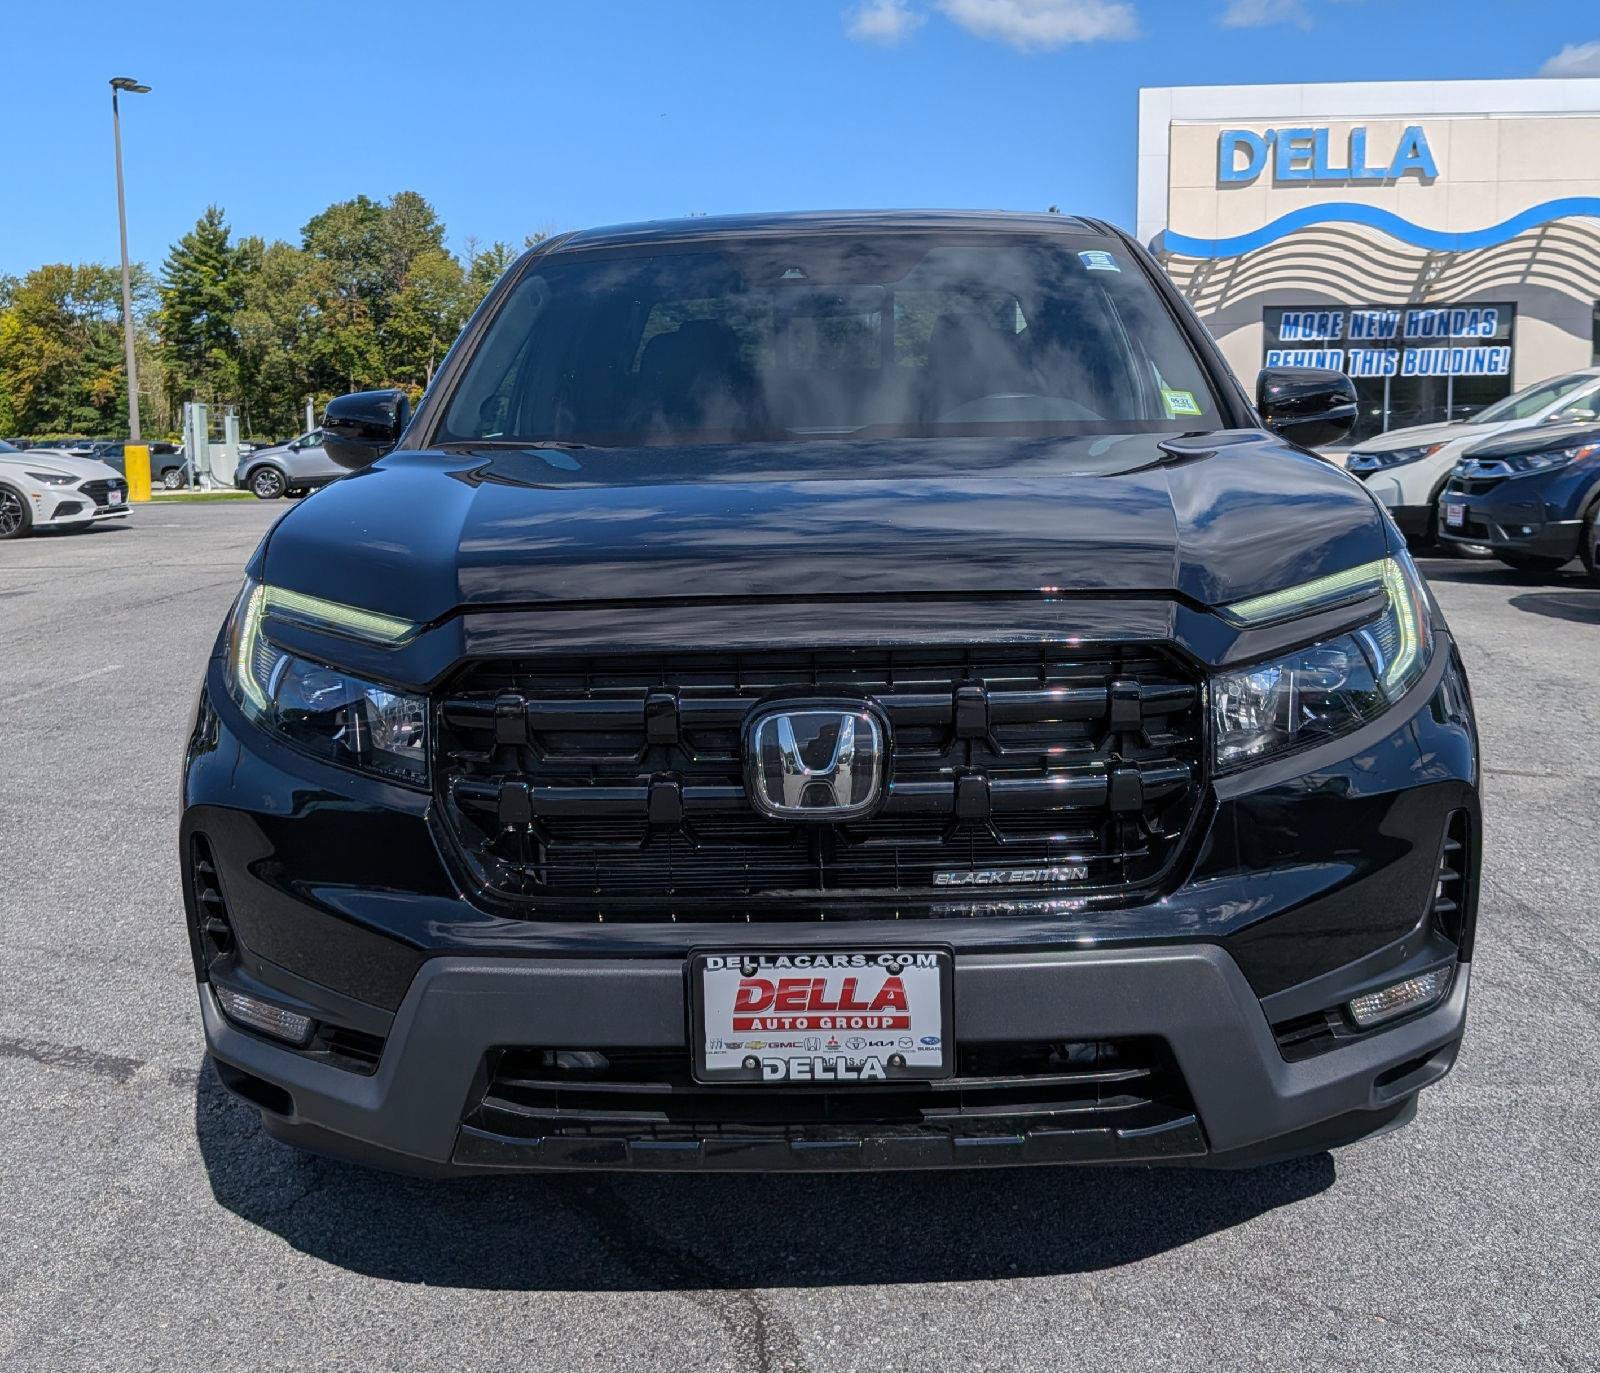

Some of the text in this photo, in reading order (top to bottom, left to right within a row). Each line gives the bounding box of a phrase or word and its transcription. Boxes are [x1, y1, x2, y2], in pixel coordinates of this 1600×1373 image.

[1217, 125, 1440, 185] D'ELLA
[1279, 308, 1498, 341] MORE NEW HONDAS
[1348, 348, 1399, 377] THIS
[1401, 346, 1511, 376] BUILDING!
[934, 867, 1087, 885] BLACK EDITION
[706, 953, 938, 971] DELLACARS.COM
[733, 976, 909, 1014] DELLA
[751, 1016, 895, 1030] AUTO GROUP
[768, 1041, 803, 1050] GMC
[762, 1055, 887, 1080] DELLA
